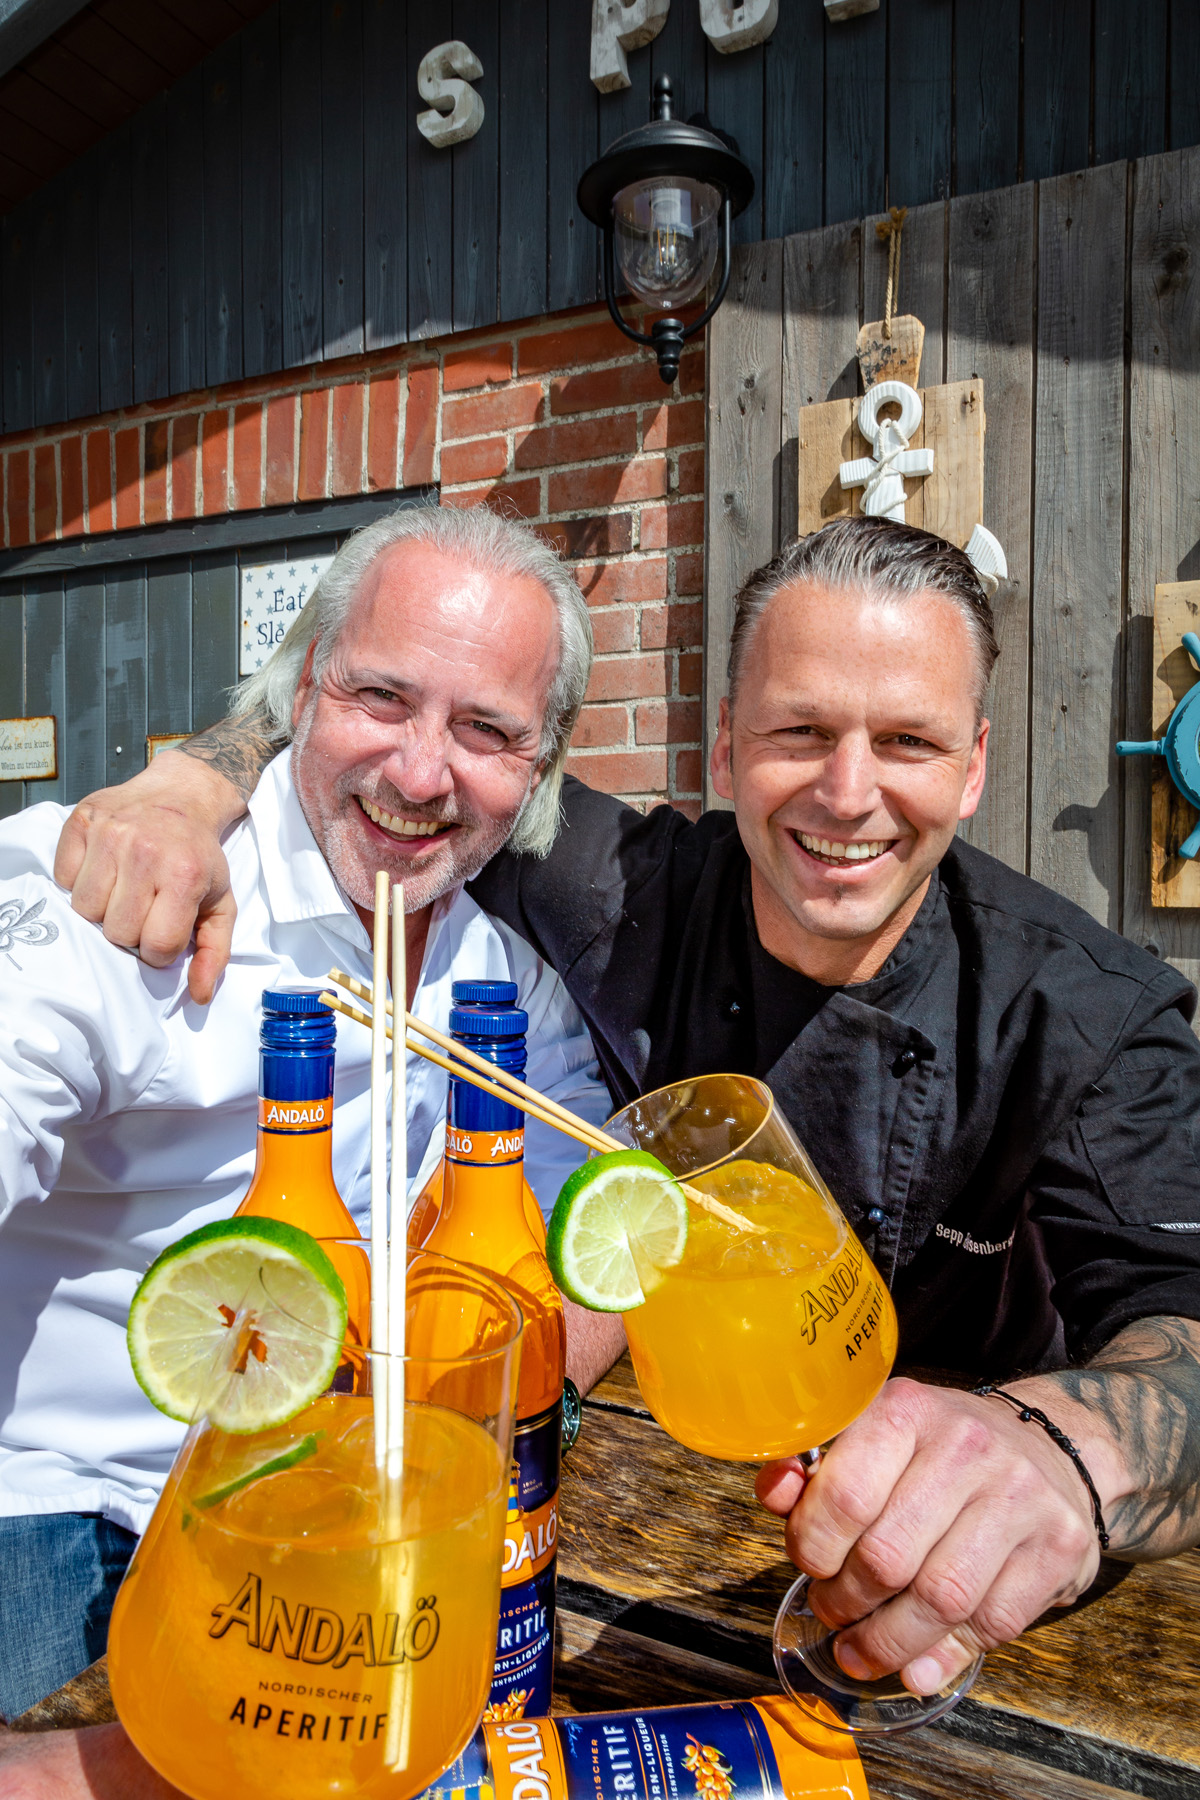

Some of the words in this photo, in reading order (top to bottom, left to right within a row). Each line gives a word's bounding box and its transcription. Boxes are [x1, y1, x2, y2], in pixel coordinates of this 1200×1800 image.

[273, 589, 306, 613] Eat
[267, 1104, 325, 1125] ANDALÖ
[935, 1222, 964, 1248] Sepp
[208, 1571, 441, 1670] ANDALÖ
[257, 1680, 374, 1705] NORDISCHER
[228, 1696, 388, 1742] APERITIF
